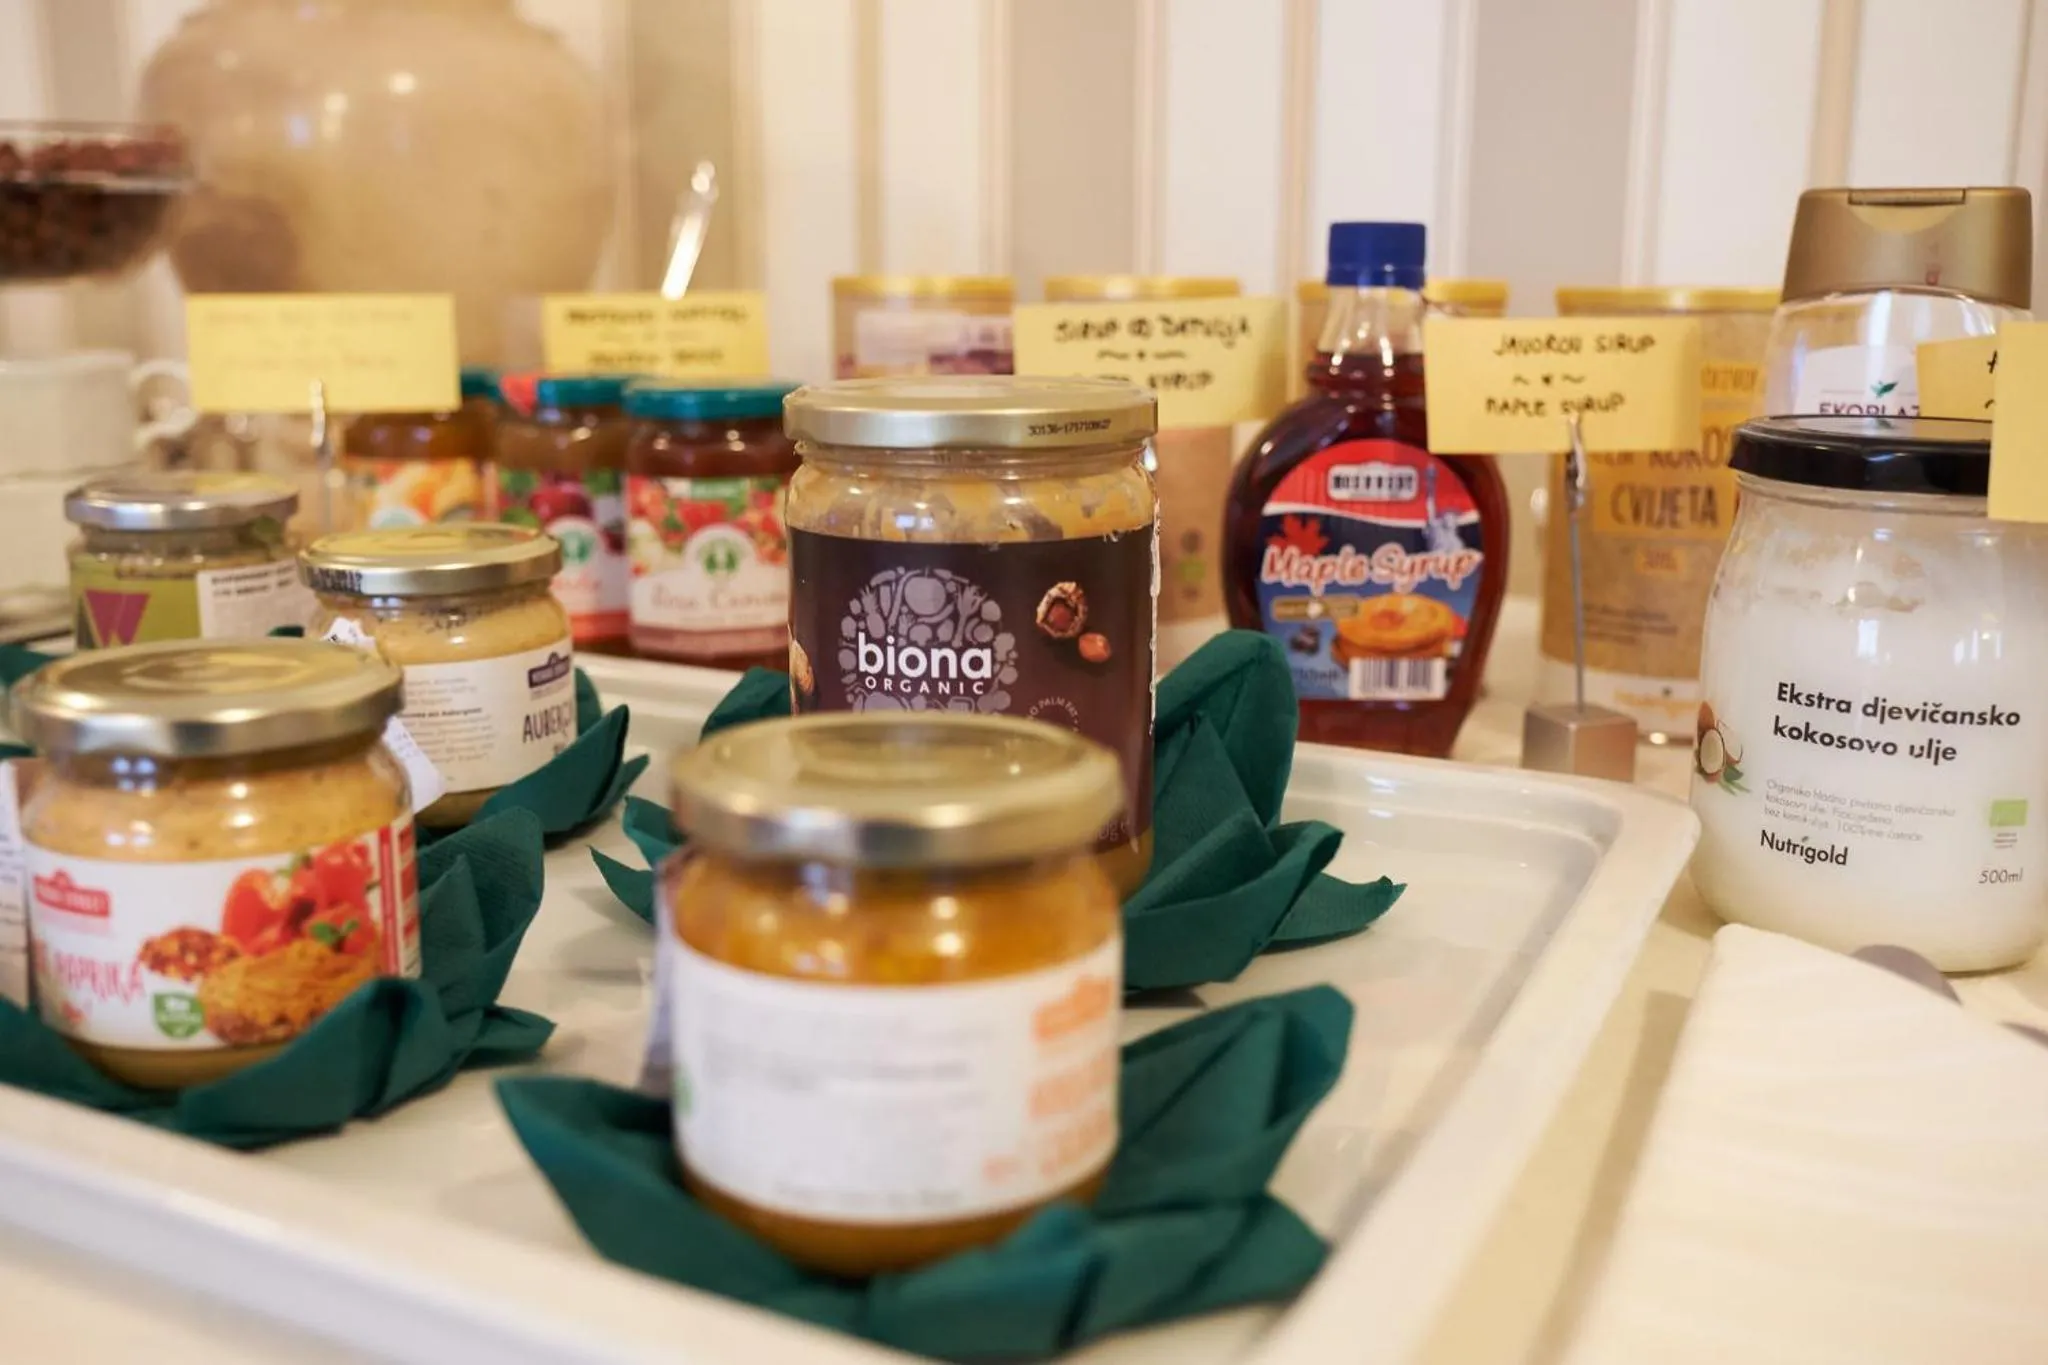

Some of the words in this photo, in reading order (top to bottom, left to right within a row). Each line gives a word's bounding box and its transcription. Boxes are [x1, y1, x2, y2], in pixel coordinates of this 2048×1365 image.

[1595, 332, 1656, 354] SIRUP
[1484, 394, 1546, 417] MAPLE
[1560, 390, 1626, 416] SYRUP
[1609, 481, 1718, 529] CVIJETA
[1261, 543, 1370, 596] Maple
[1371, 541, 1483, 595] Syrup
[858, 631, 992, 679] biona
[864, 675, 985, 695] ORGANIC
[1038, 696, 1066, 709] PALM
[1777, 682, 1851, 714] Ekstra
[1862, 696, 2020, 727] djevičansko
[1773, 715, 1898, 756] kokosovo
[1909, 738, 1957, 766] ulje
[1760, 829, 1849, 866] Nutrigold
[1977, 866, 2024, 885] 500ml
